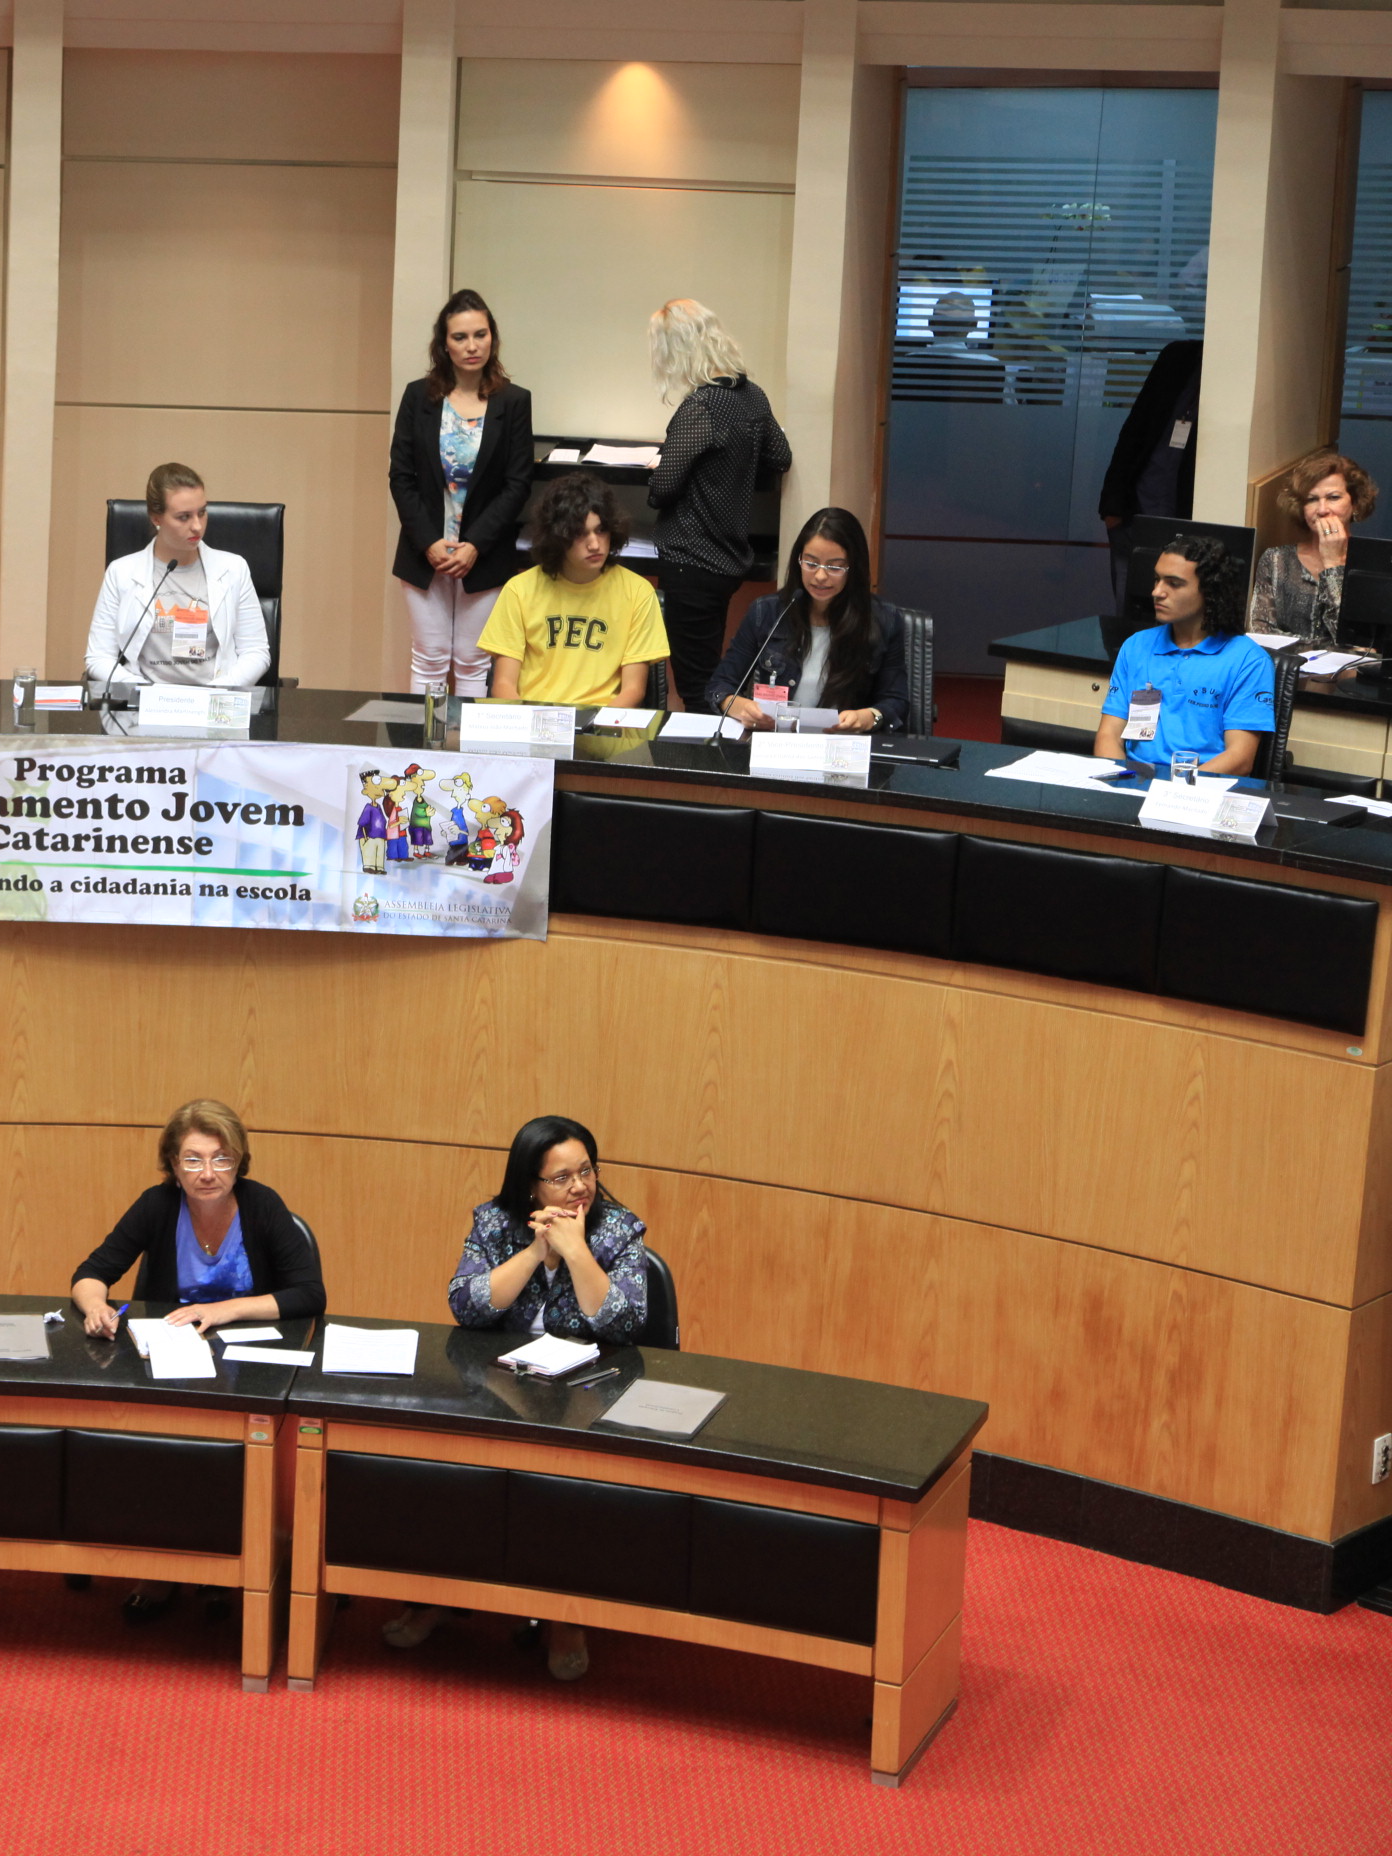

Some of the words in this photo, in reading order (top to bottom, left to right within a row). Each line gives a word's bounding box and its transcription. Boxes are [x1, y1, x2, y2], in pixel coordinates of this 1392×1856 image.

[545, 614, 608, 652] PEC
[159, 695, 195, 704] Presidente
[14, 757, 187, 789] Programa
[161, 791, 305, 827] Jovem
[50, 879, 63, 894] a
[70, 876, 192, 897] cidadania
[198, 883, 229, 899] na
[236, 882, 311, 901] escola
[383, 912, 396, 920] DO
[398, 912, 429, 921] ESTADO
[444, 914, 469, 923] SANTA
[471, 915, 512, 925] CATARINA
[384, 900, 444, 912] ASSEMBLEIA
[448, 903, 512, 915] LEGISLATIVA
